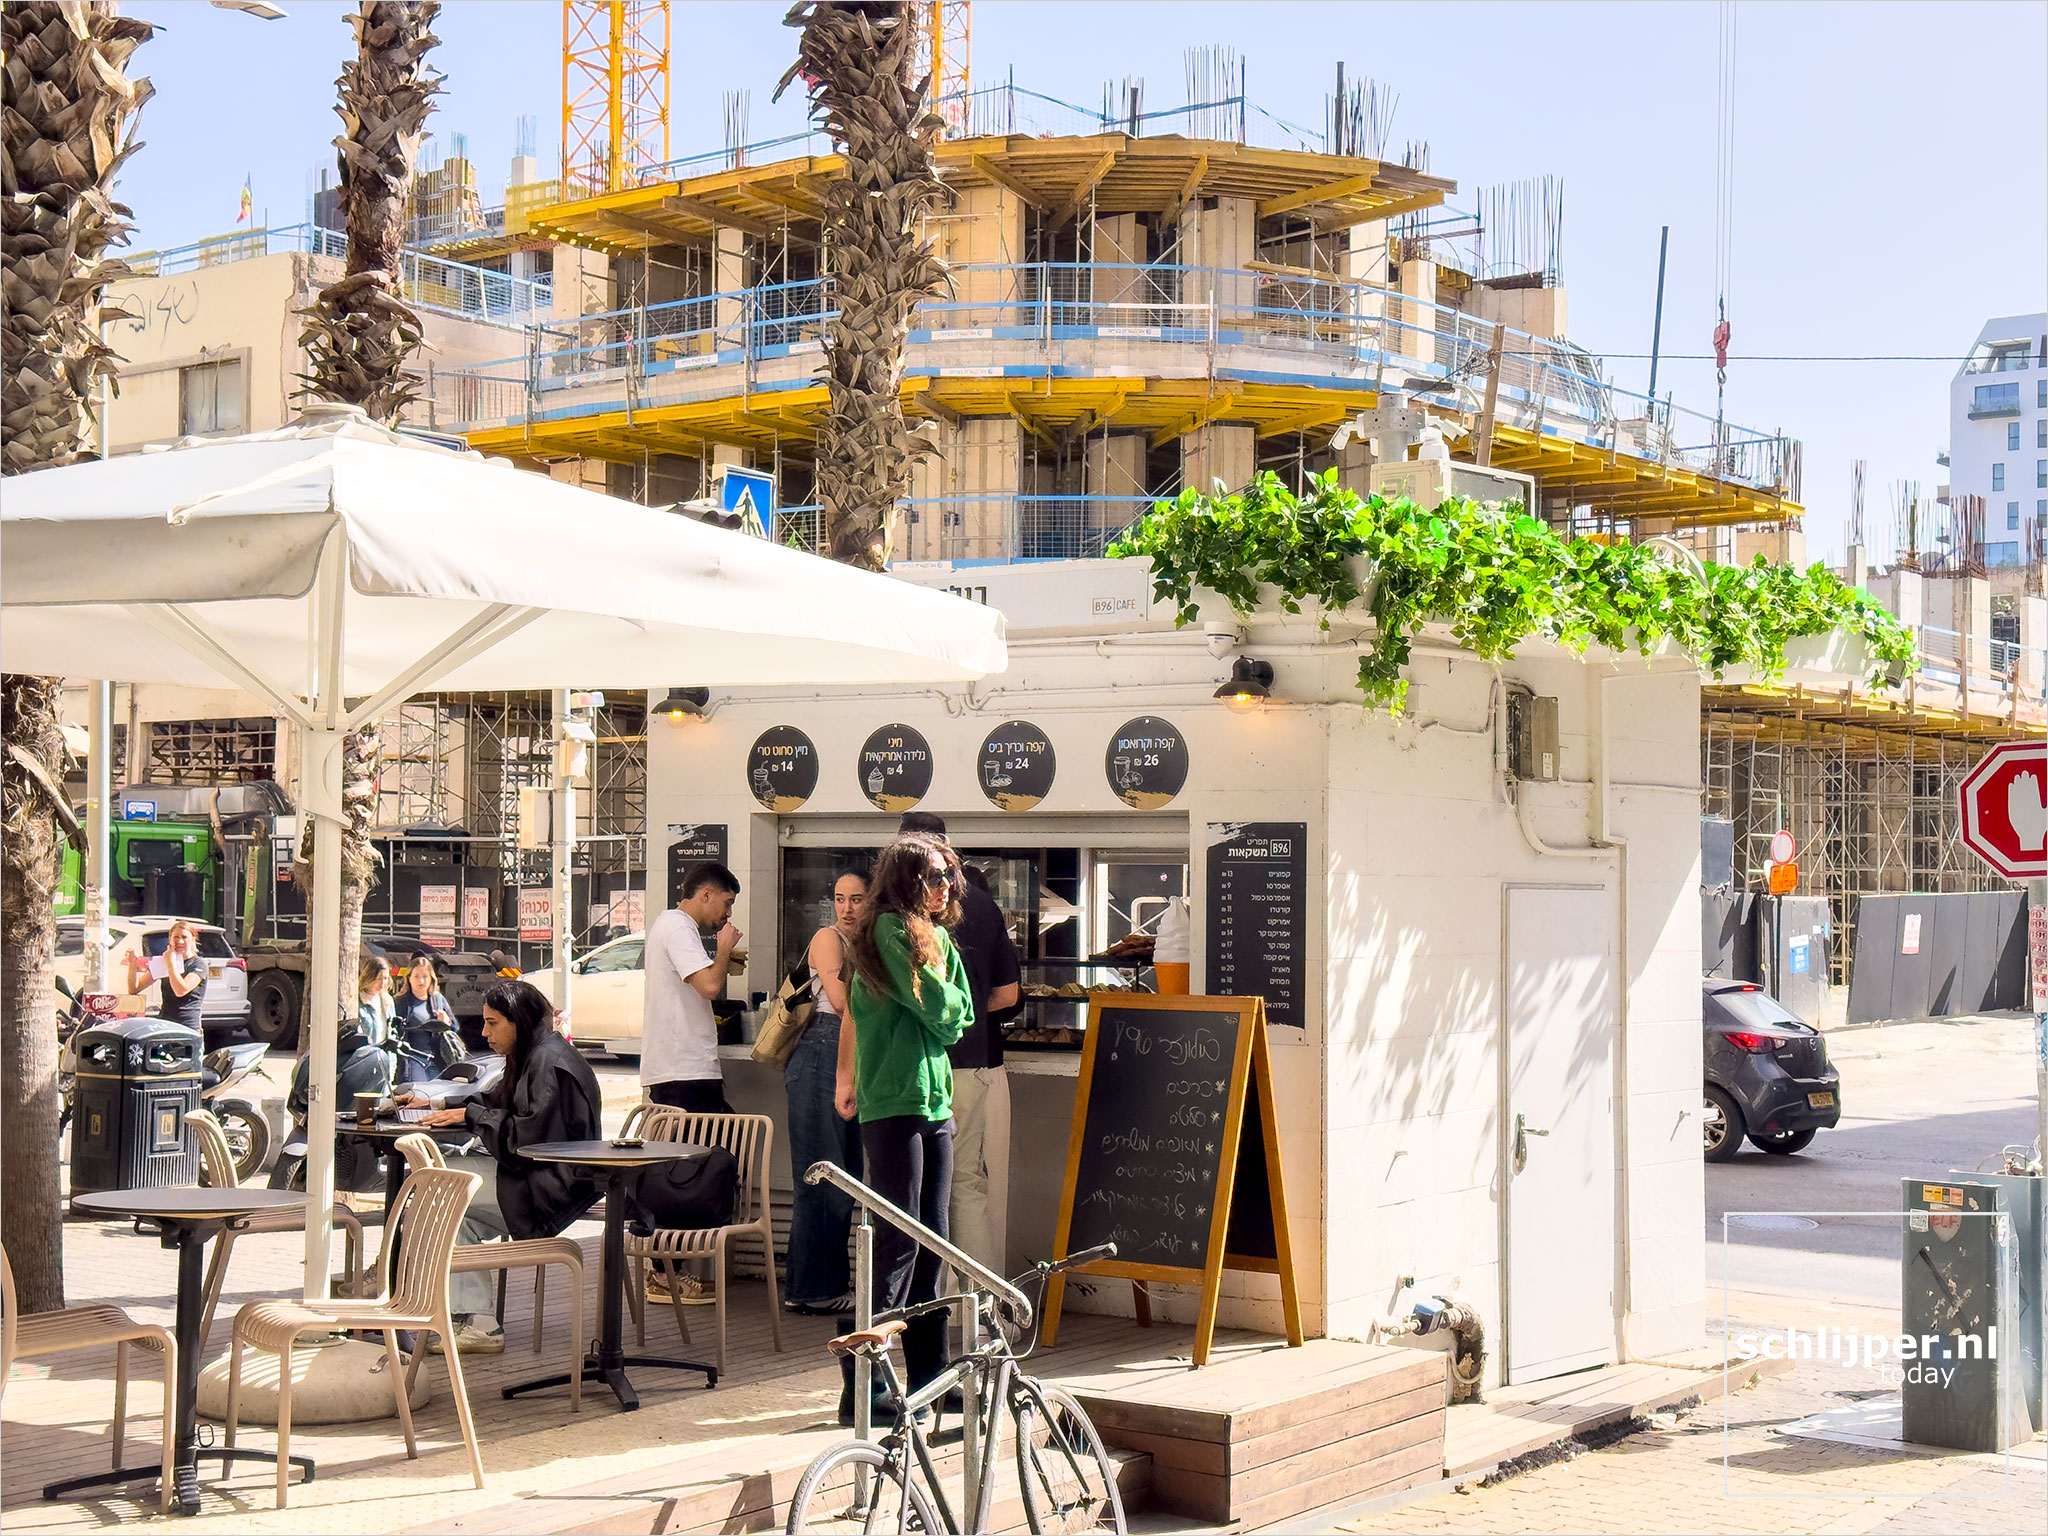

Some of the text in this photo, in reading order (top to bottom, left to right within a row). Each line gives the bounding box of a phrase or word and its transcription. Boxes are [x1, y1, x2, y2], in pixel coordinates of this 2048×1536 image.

[888, 737, 903, 748] מיני
[1118, 738, 1175, 753] קפה וקרואסון
[757, 745, 808, 758] מיץ סחוט טרי
[988, 742, 1045, 756] קפה וכריך ביס
[865, 750, 925, 764] גלידה אמריקאית
[1144, 754, 1159, 766] 26
[781, 761, 793, 772] 14
[896, 764, 903, 775] 4
[1015, 758, 1029, 769] 24
[1228, 848, 1268, 859] משקאות
[1272, 842, 1289, 854] B96
